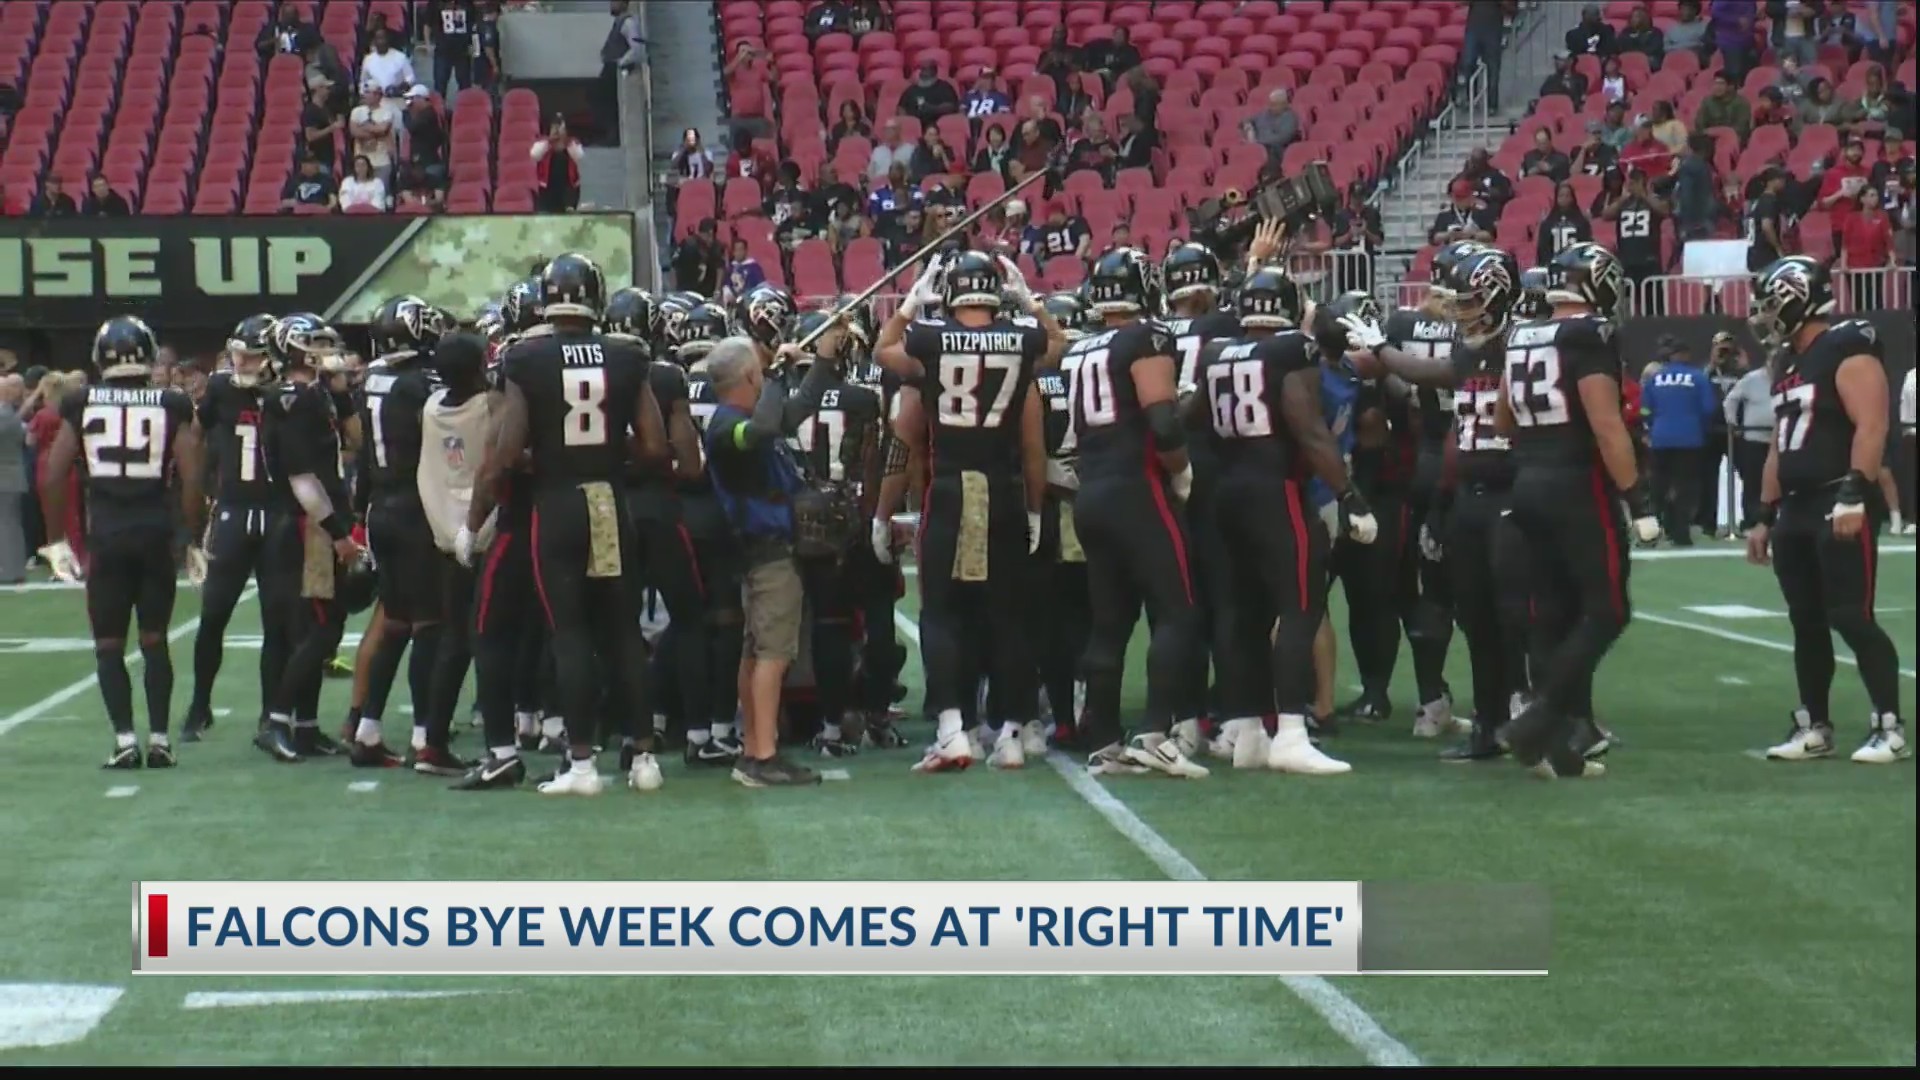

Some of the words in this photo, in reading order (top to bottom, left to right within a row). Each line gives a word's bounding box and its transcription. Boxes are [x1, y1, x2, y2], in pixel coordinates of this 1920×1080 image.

[967, 98, 995, 119] 18
[1047, 231, 1074, 252] 21
[1620, 209, 1650, 238] 23
[190, 236, 332, 296] UP
[561, 344, 604, 364] PITTS
[941, 332, 1024, 351] FITZPATRICK
[562, 367, 607, 446] 8
[820, 389, 840, 407] ES
[938, 354, 1022, 428] 87
[1061, 349, 1117, 432] 70
[1206, 360, 1273, 440] 68
[1506, 346, 1570, 427] 63
[82, 406, 166, 478] 29
[234, 424, 257, 481] 1
